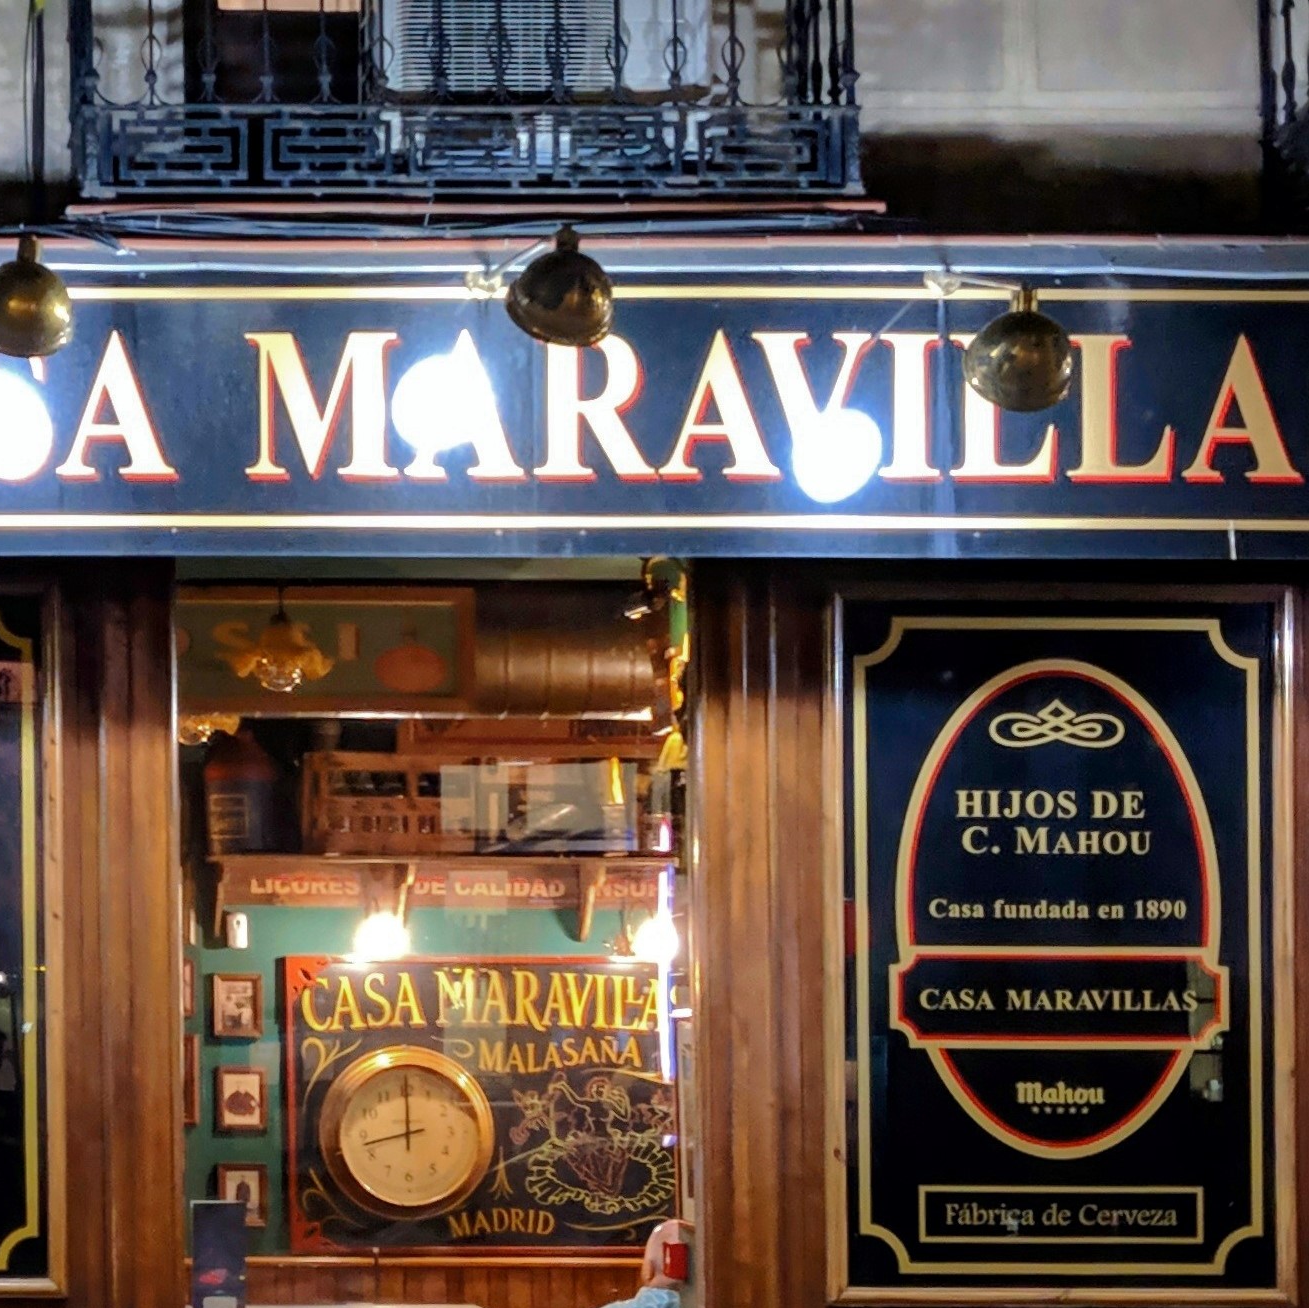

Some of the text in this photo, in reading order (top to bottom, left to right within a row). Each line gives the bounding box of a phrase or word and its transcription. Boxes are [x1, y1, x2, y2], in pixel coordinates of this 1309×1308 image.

[955, 789, 1146, 819] HIJOS DE
[961, 825, 1152, 856] C. MAHOU
[928, 898, 1188, 920] Casa fundada en 1890
[301, 973, 427, 1032] CASA
[919, 987, 1200, 1013] CASA MARAVILLAS
[478, 1035, 643, 1075] MALASAÑA
[447, 1207, 557, 1239] MADRID
[945, 1202, 1179, 1228] Fábrica de Cerveza
